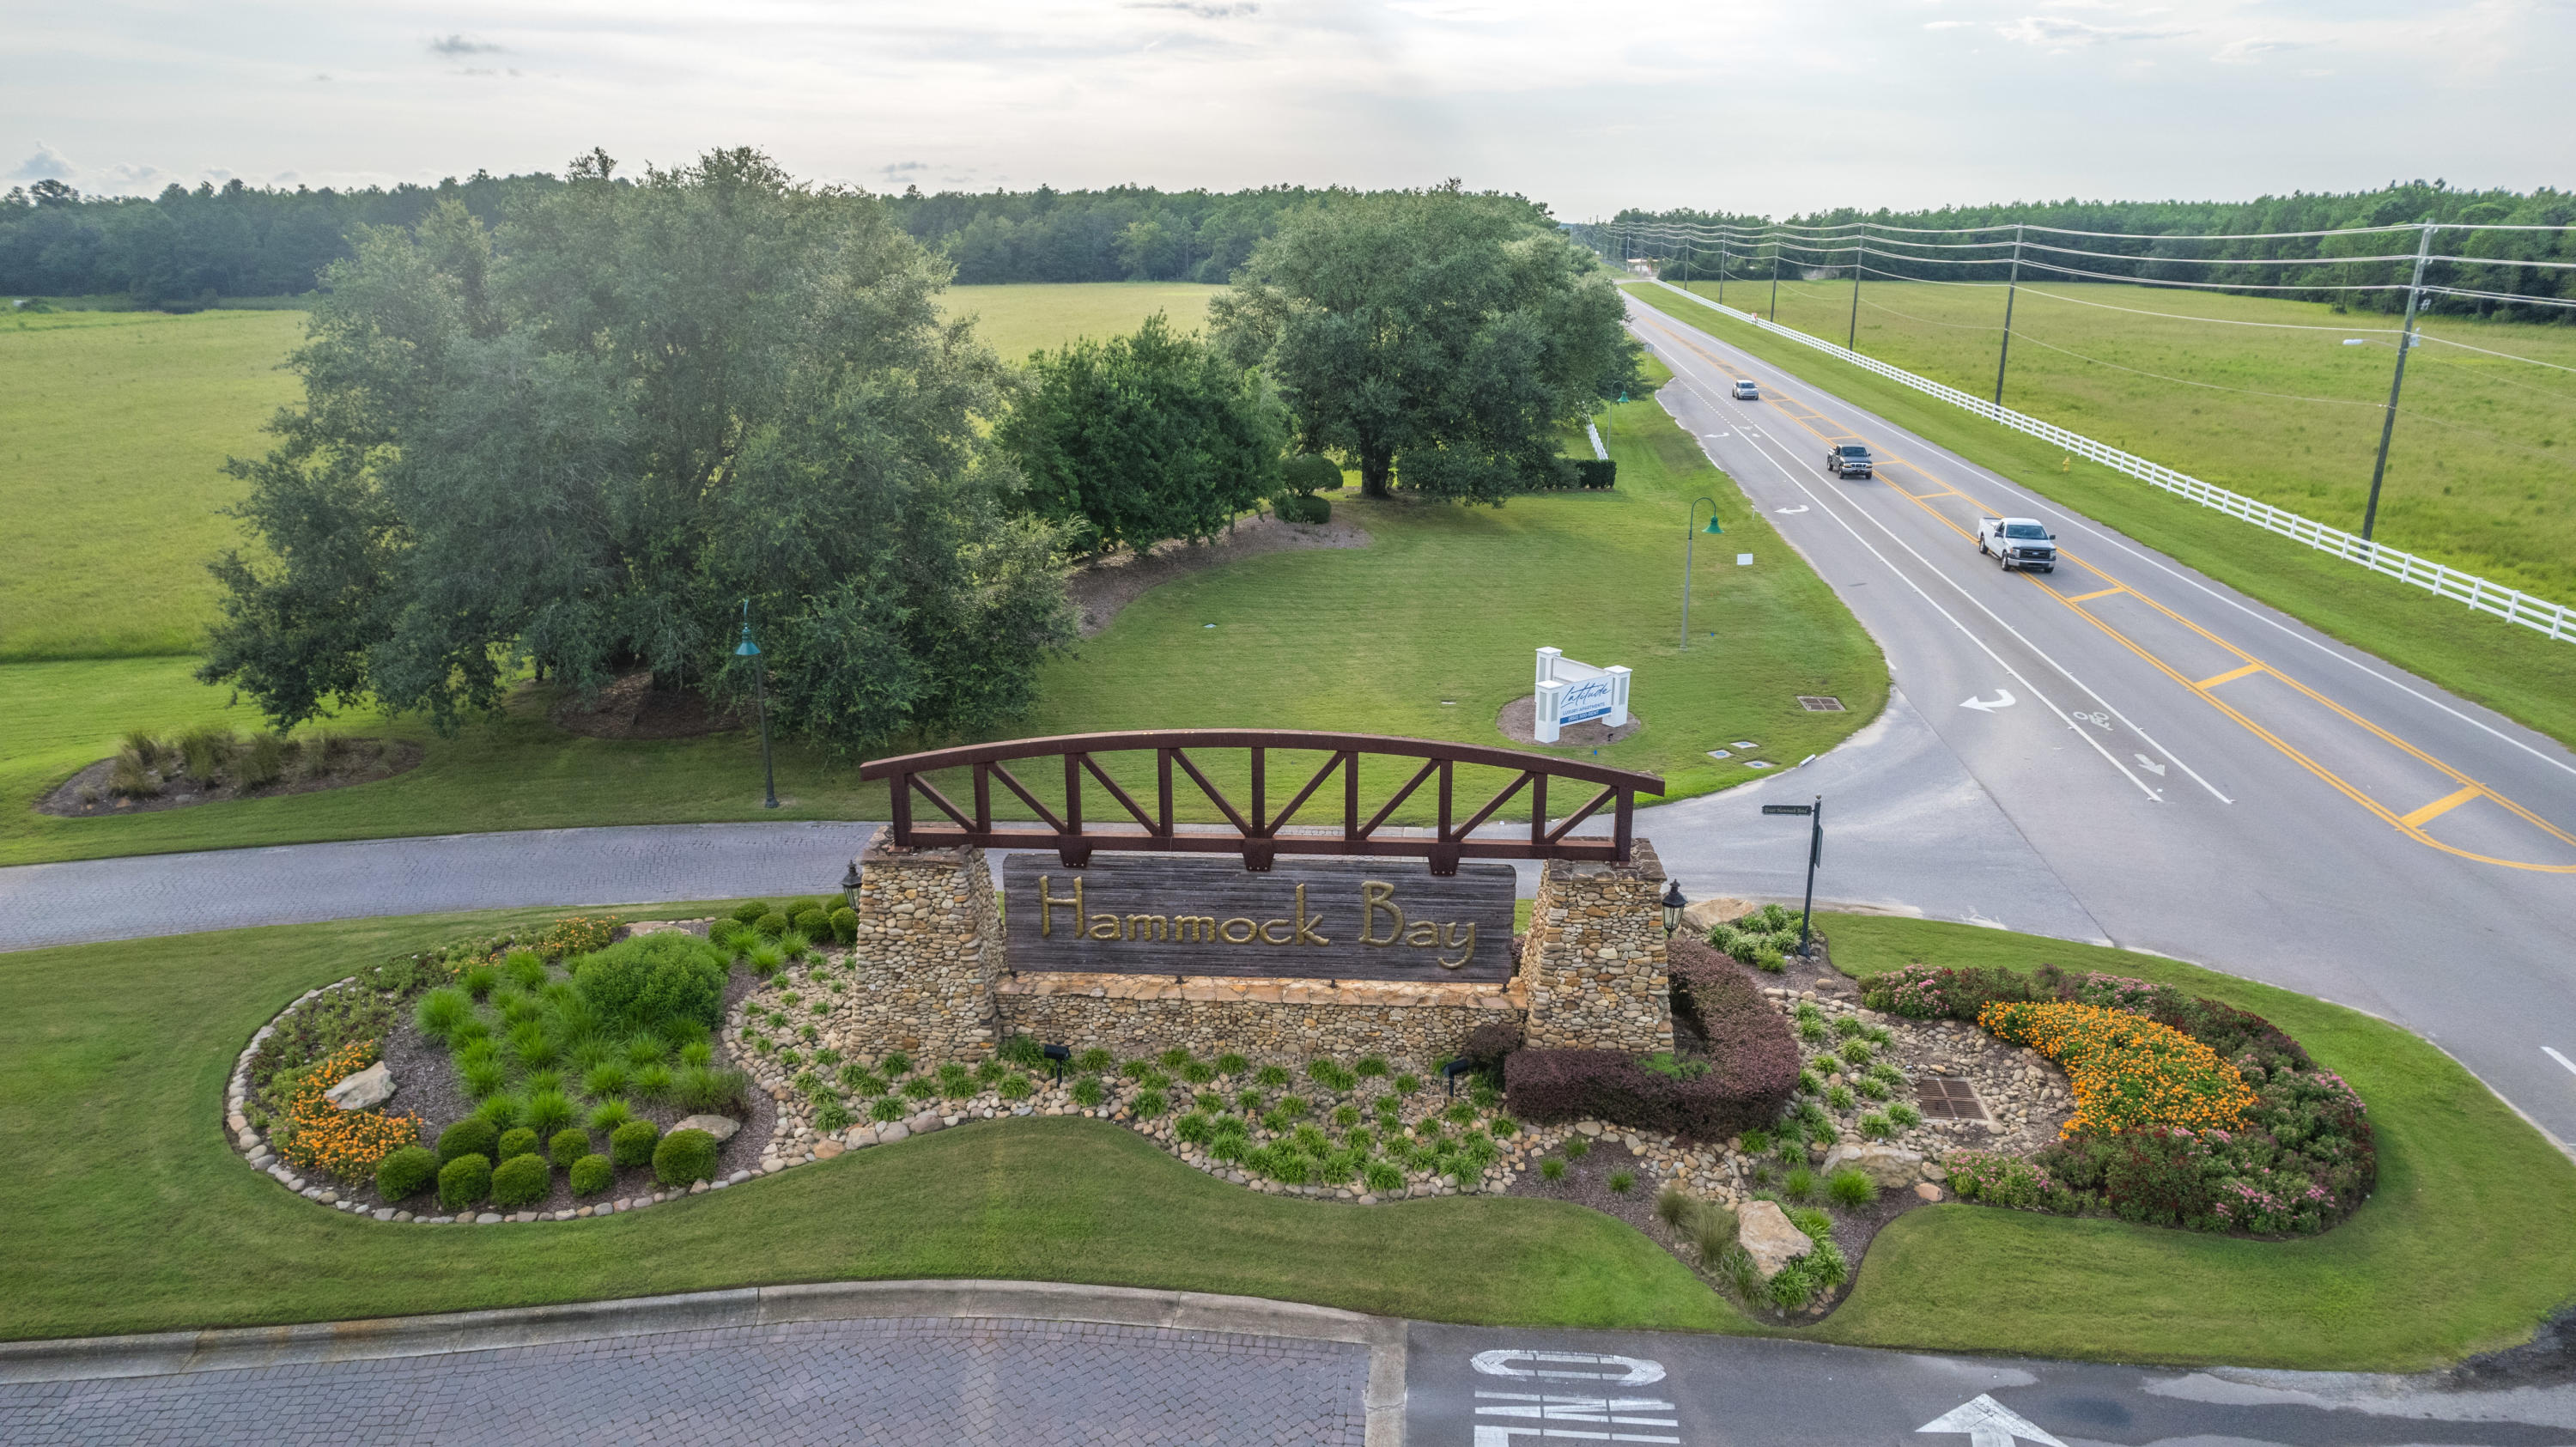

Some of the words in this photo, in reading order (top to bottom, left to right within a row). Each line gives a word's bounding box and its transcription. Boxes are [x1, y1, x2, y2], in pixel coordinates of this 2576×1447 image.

[1560, 682, 1611, 708] Latitude
[1038, 874, 1330, 946] Hammock
[1358, 880, 1476, 970] Bay
